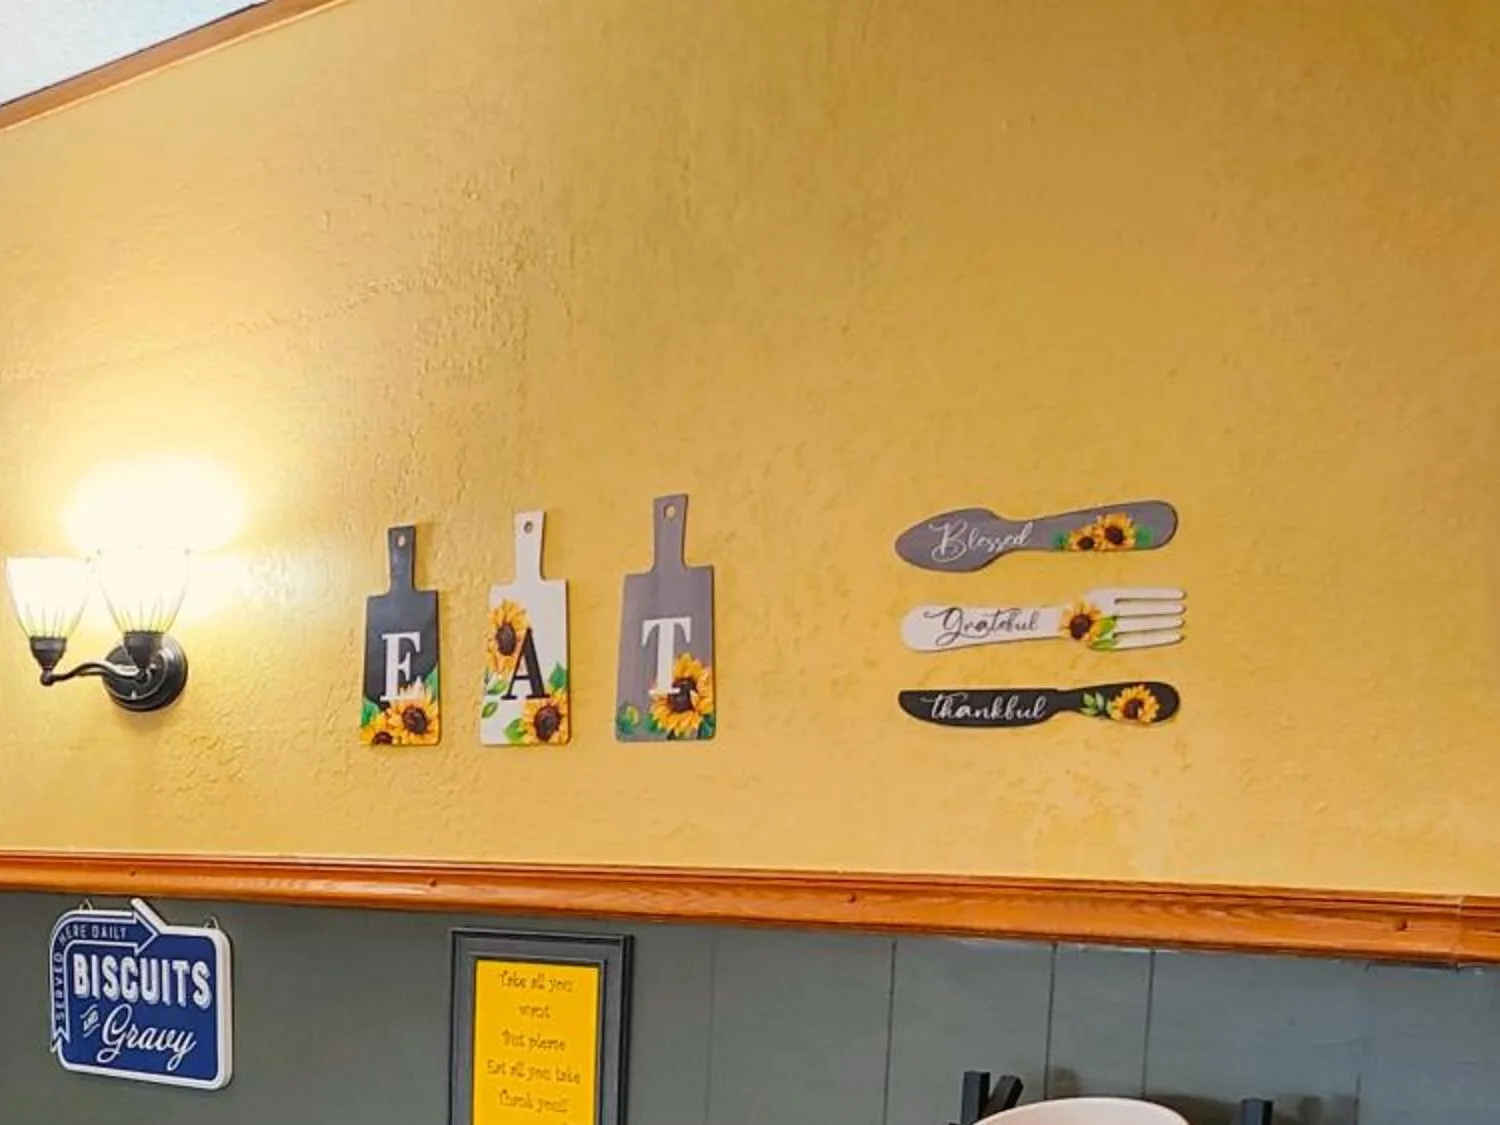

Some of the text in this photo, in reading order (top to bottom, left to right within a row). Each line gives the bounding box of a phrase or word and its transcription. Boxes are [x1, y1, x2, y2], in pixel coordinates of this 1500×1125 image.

[928, 518, 1034, 563] Blessed
[922, 606, 1041, 647] Grateful
[379, 616, 691, 701] E A T
[57, 923, 87, 945] HERE
[91, 925, 128, 941] DAILY
[73, 952, 213, 1010] BISCUITS
[96, 1002, 198, 1071] Gravy
